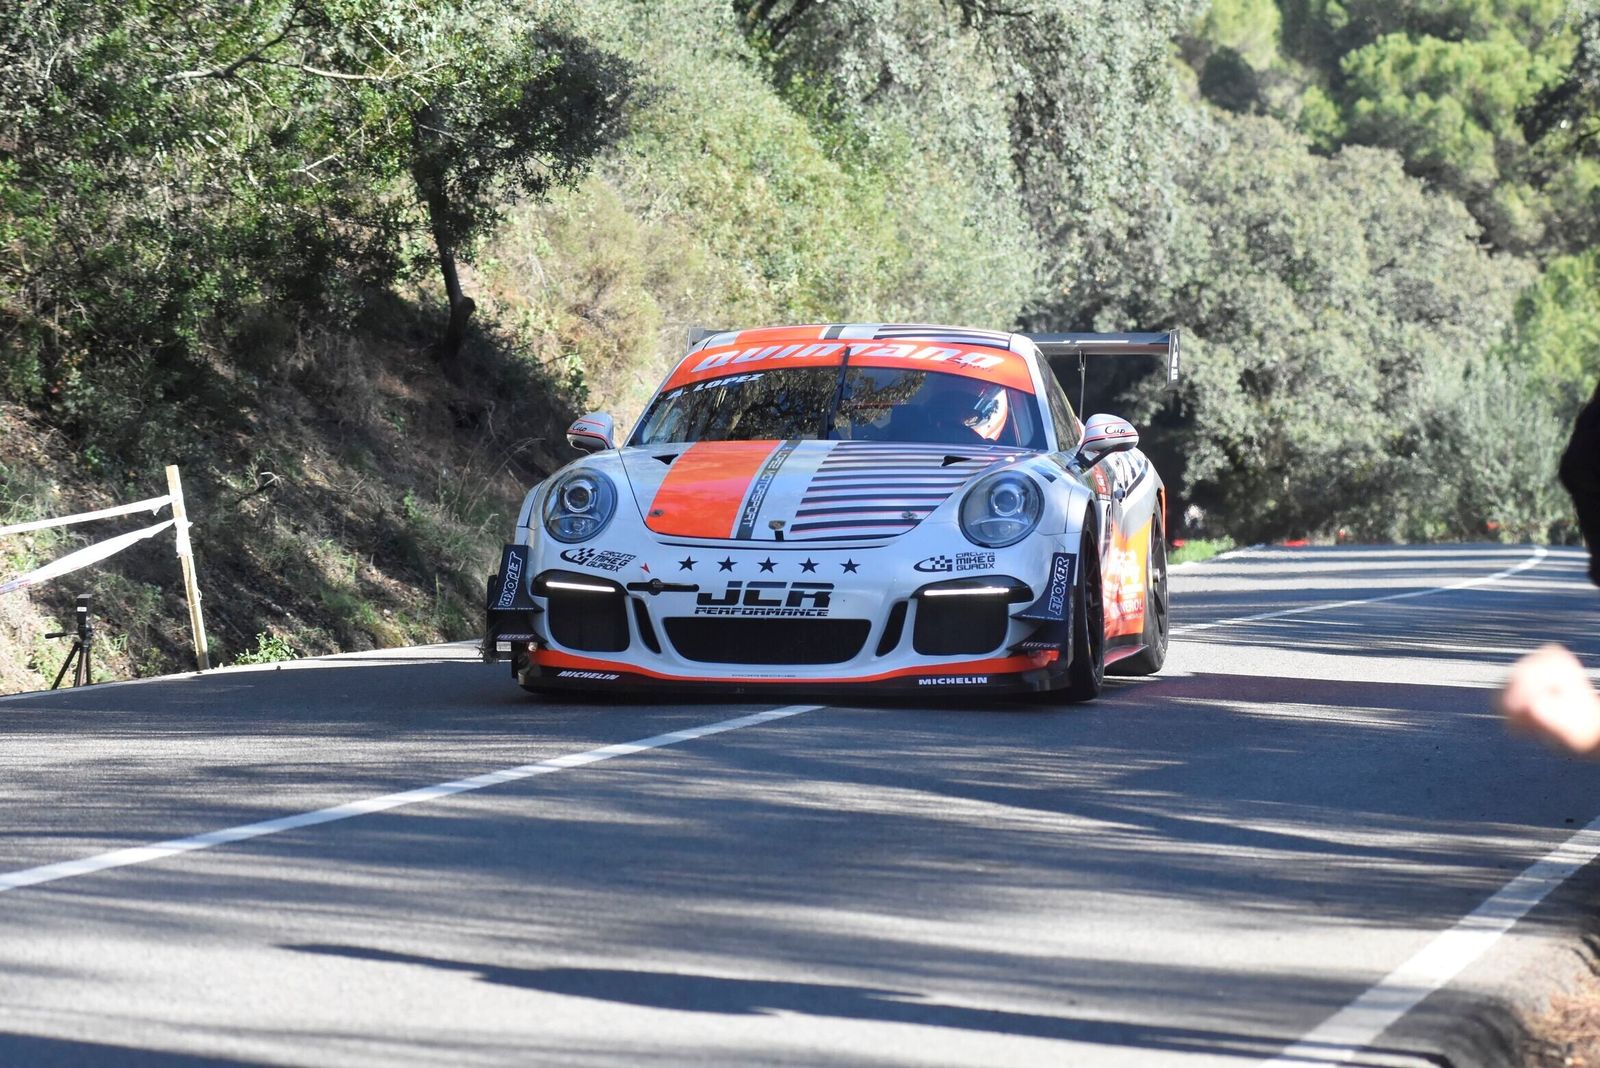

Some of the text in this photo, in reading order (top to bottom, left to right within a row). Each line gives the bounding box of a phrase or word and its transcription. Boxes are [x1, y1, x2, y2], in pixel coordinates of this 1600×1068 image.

[693, 373, 765, 392] LOPEZ
[572, 422, 588, 432] Cup
[1104, 425, 1126, 435] Cup
[592, 554, 622, 565] MIKE
[600, 550, 637, 560] CIRCUITO
[955, 555, 996, 565] MIKE G
[586, 561, 623, 572] GUADIX
[956, 562, 995, 571] GUADIX
[696, 581, 835, 608] JCR
[694, 607, 830, 617] PERFORMANCE
[557, 670, 620, 680] MICHELIN
[918, 676, 988, 686] MICHELIN
